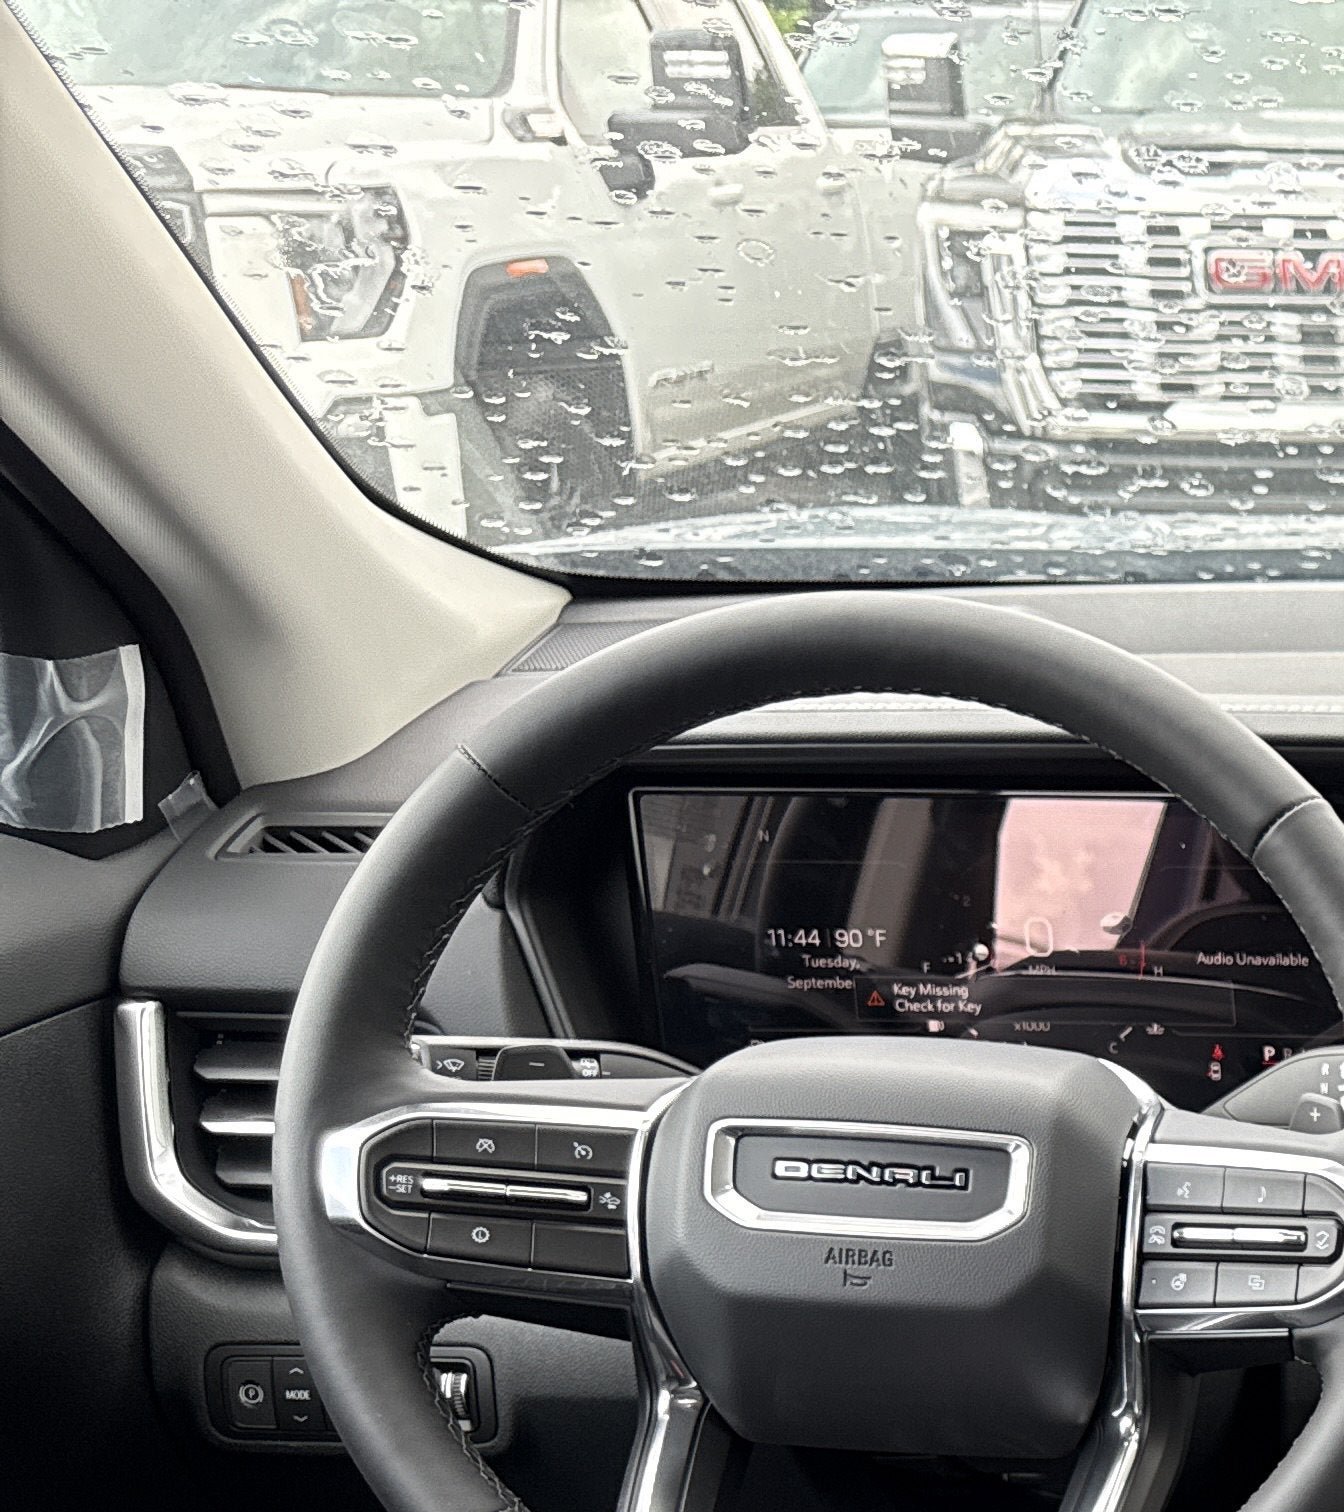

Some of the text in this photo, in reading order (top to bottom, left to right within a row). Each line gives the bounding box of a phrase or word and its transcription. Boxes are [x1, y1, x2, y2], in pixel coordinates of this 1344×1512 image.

[767, 929, 821, 948] 11:44
[835, 929, 863, 948] 90
[1024, 916, 1053, 957] 0
[802, 954, 861, 970] Tuesday,
[1197, 952, 1310, 967] Audio Unavailable
[893, 983, 969, 998] Key Missing
[896, 1000, 982, 1016] Check for Key
[1264, 1045, 1276, 1062] P
[772, 1157, 971, 1191] DENALI
[824, 1248, 894, 1267] AIRBAG
[285, 1390, 310, 1400] MODE
